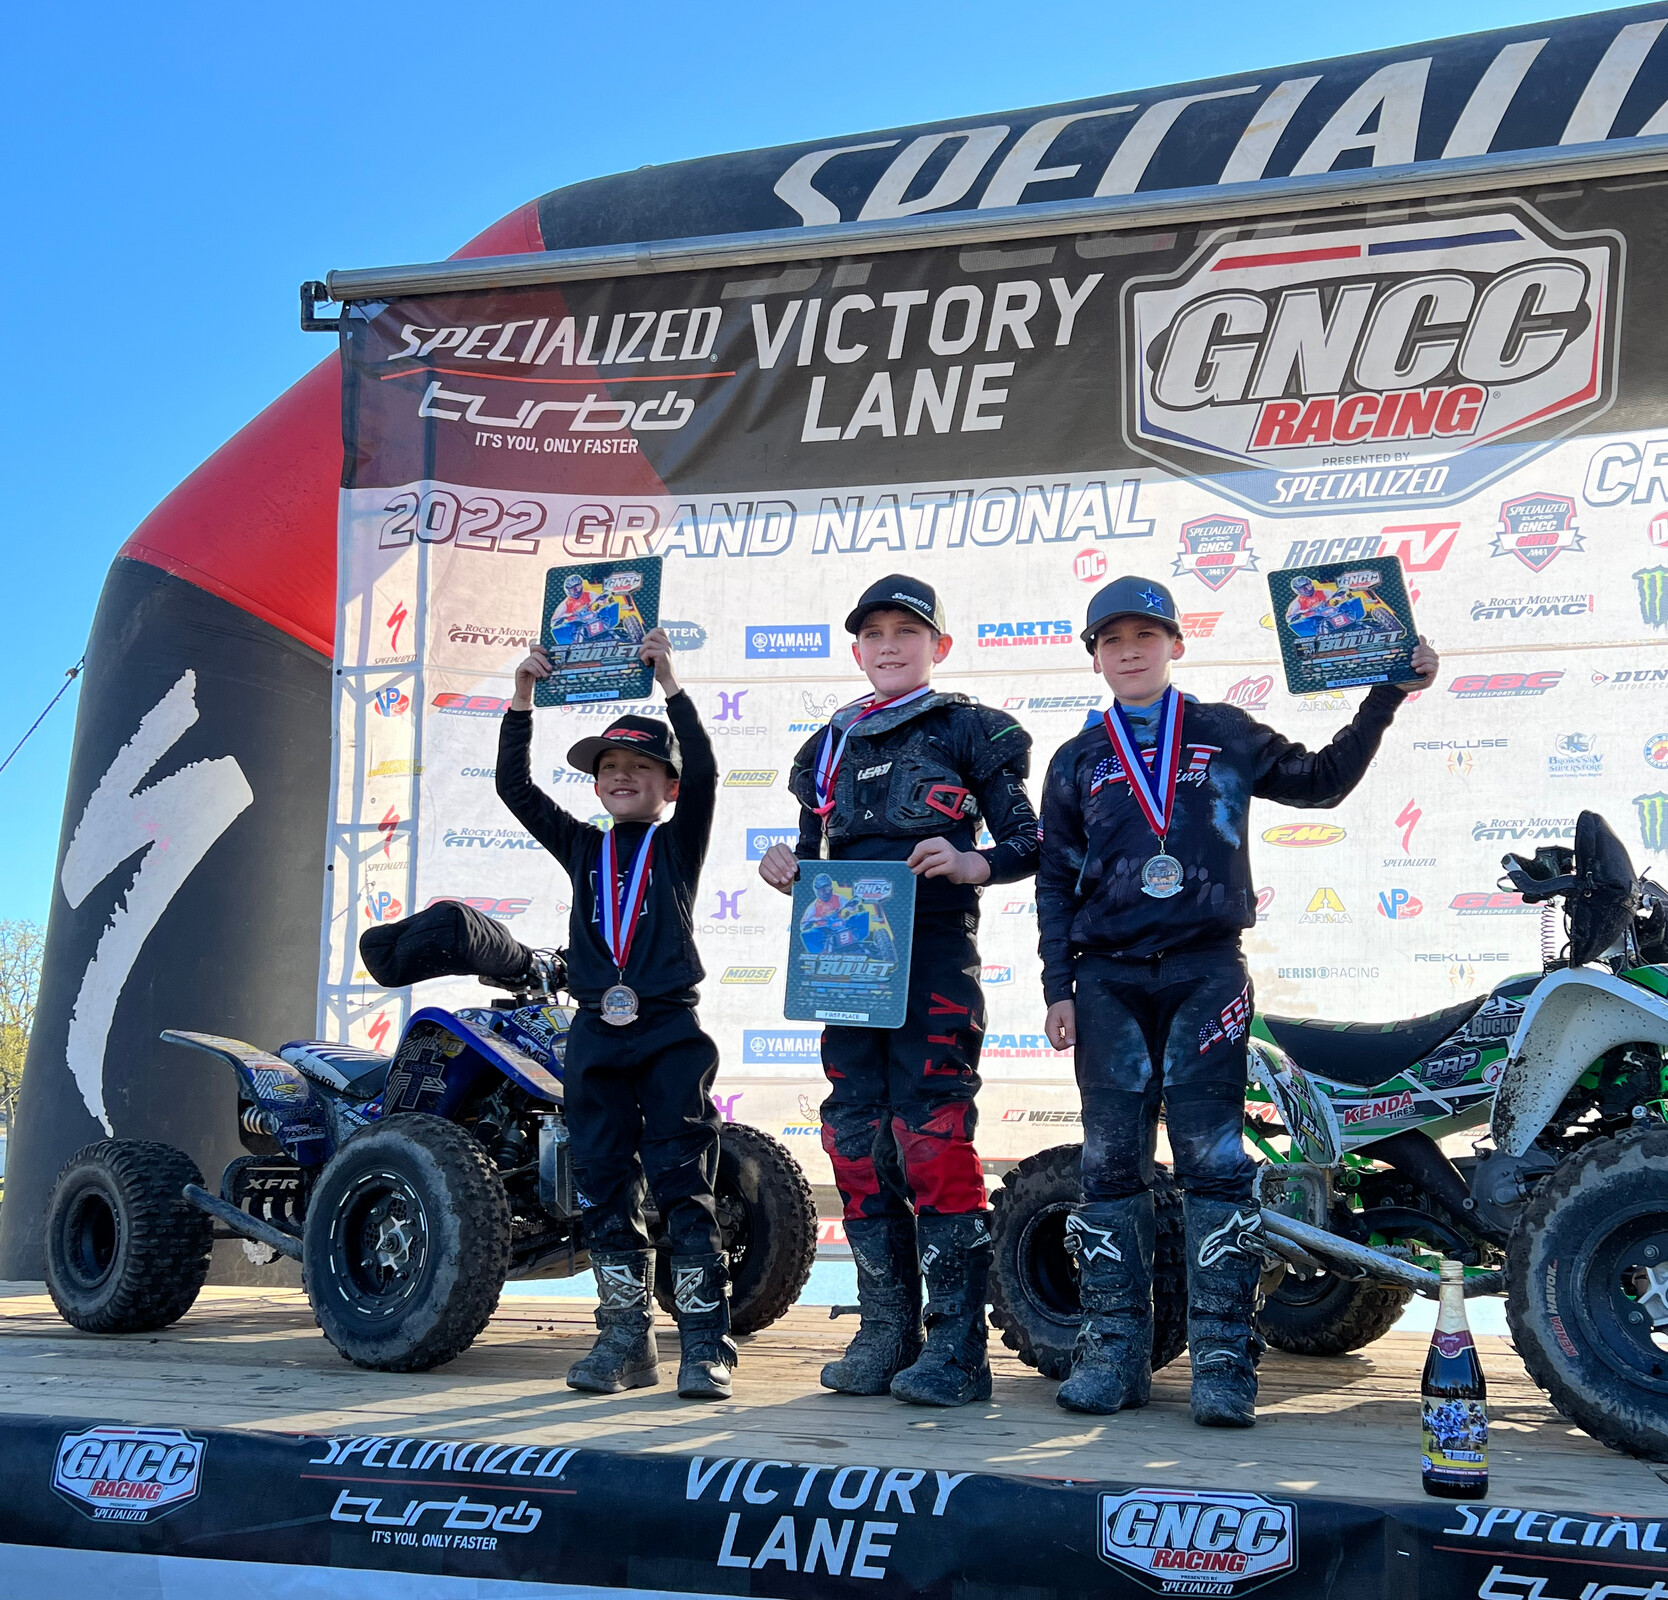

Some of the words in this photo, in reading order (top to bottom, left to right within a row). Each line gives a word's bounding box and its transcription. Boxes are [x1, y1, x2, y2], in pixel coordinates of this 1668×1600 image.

[751, 272, 1105, 370] VICTORY
[387, 306, 723, 366] SPECIALIZED
[1151, 258, 1590, 410] GNCC
[801, 361, 1016, 443] LANE
[1249, 383, 1485, 451] RACING
[474, 431, 503, 448] IT'S
[506, 434, 540, 454] YOU,
[543, 437, 582, 454] ONLY
[583, 438, 639, 455] FASTER
[1322, 453, 1391, 467] PRESENTED
[1394, 451, 1411, 462] BY
[1267, 465, 1450, 505] SPECIALIZED
[1507, 503, 1568, 516] SPECIALIZED
[378, 489, 548, 556] 2022
[562, 501, 798, 559] GRAND
[811, 478, 1157, 556] NATIONAL
[1518, 520, 1558, 532] GNCC
[1187, 524, 1244, 537] SPECIALIZED
[1197, 541, 1234, 552] GNCC
[1339, 574, 1378, 587] GNCC
[1489, 597, 1525, 606] ROCKY
[1527, 594, 1588, 605] MOUNTAIN
[465, 623, 497, 635] ROCKY
[977, 620, 1073, 638] PARTS
[768, 632, 823, 647] YAMAHA
[977, 635, 1073, 648] UNLIMITED
[1318, 630, 1402, 652] BULLET
[567, 643, 643, 663] BULLET
[1333, 678, 1360, 687] SECOND
[1449, 671, 1564, 692] GBC
[1459, 690, 1517, 698] POWERSPORTS
[1519, 688, 1543, 696] TIRES
[375, 687, 401, 718] VP
[1297, 700, 1352, 711] ARMA
[1412, 738, 1510, 751] REKLUSE
[729, 772, 774, 782] MOOSE
[1490, 818, 1526, 828] ROCKY
[460, 827, 493, 837] ROCKY
[1270, 828, 1345, 843] FMF
[1382, 858, 1436, 868] SPECIALIZED
[855, 883, 891, 895] GNCC
[368, 891, 392, 922] VP
[1378, 888, 1409, 920] VP
[1298, 913, 1353, 923] ARMA
[1414, 953, 1510, 962] REKLUSE
[725, 968, 772, 979] MOOSE
[817, 961, 895, 977] BULLET
[1343, 1090, 1414, 1126] KENDA
[1388, 1103, 1415, 1120] TIRES
[244, 1178, 299, 1190] XFR
[1550, 1315, 1579, 1357] KENDA
[61, 1438, 197, 1486] GNCC
[308, 1436, 581, 1478] SPECIALIZED
[88, 1479, 164, 1502] RACING
[685, 1455, 977, 1516] VICTORY
[92, 1507, 148, 1522] SPECIALIZED
[1109, 1500, 1286, 1556] GNCC
[371, 1530, 391, 1544] IT'S
[393, 1532, 419, 1548] YOU,
[421, 1533, 453, 1548] ONLY
[453, 1535, 498, 1551] FASTER
[716, 1512, 899, 1580] LANE
[1151, 1548, 1248, 1573] RACING
[1159, 1581, 1234, 1595] SPECIALIZED
